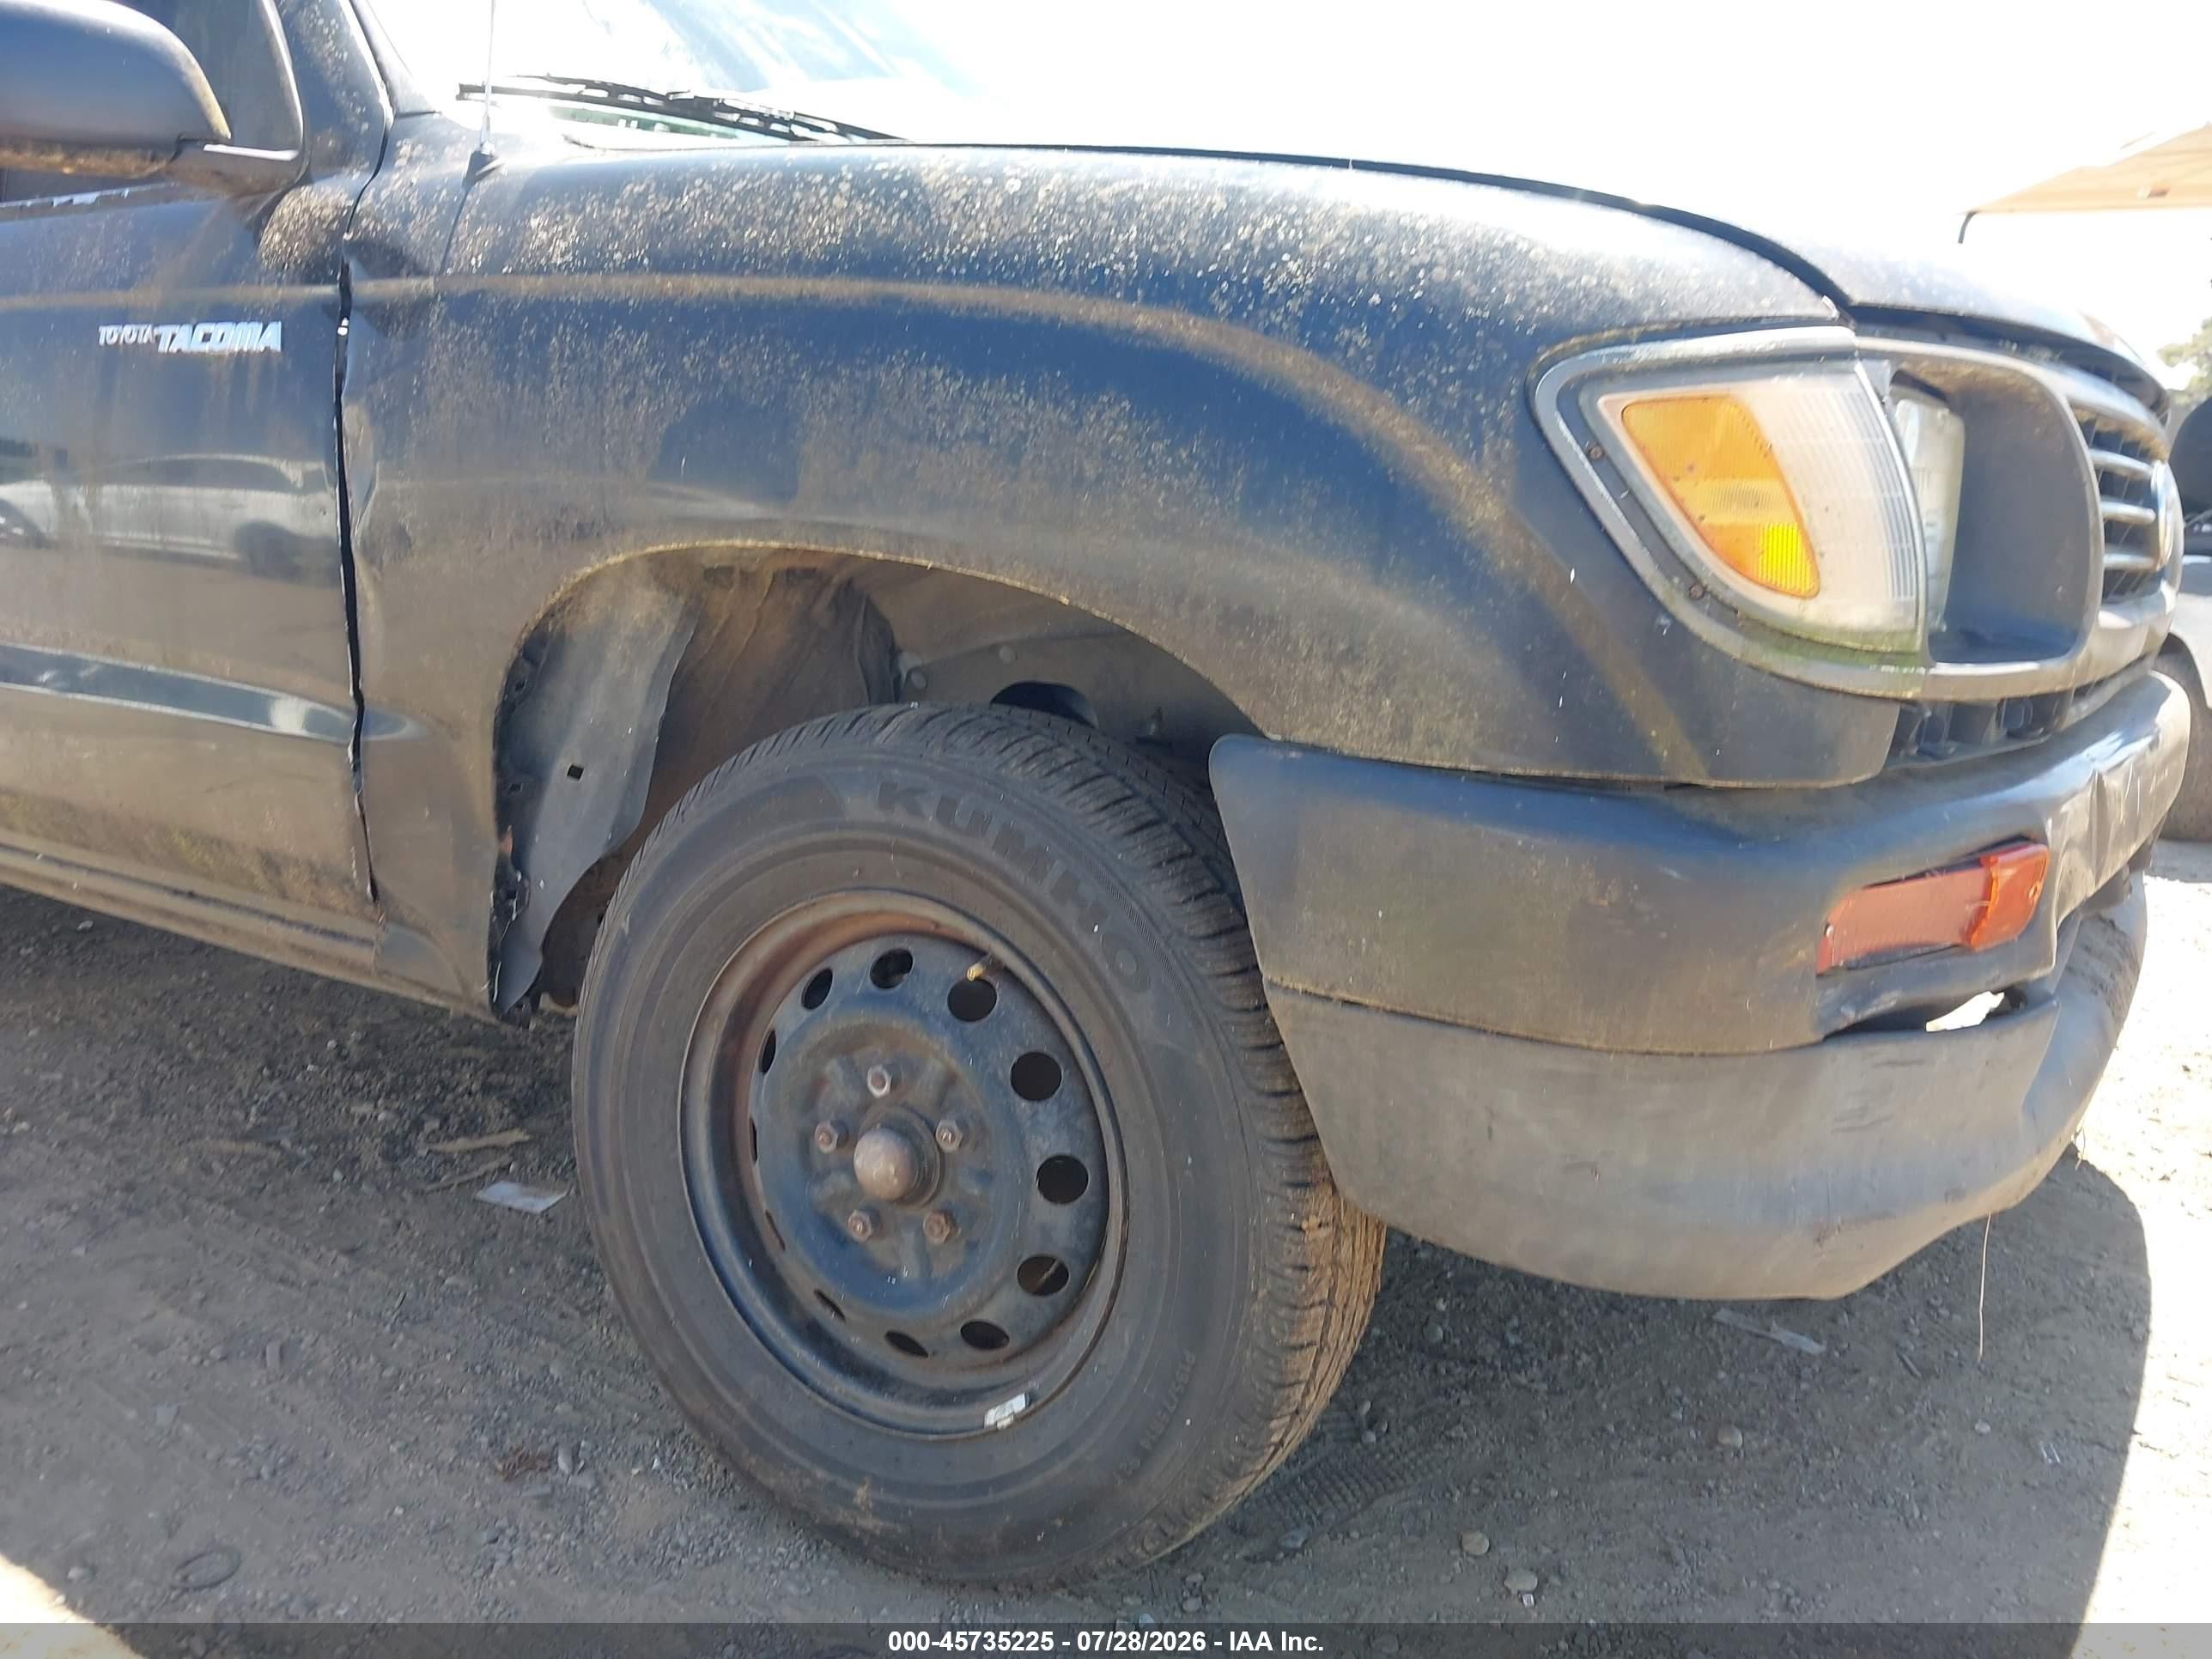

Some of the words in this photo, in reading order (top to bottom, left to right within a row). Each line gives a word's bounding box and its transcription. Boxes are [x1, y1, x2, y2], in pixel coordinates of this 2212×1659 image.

[98, 324, 154, 346] TOYOTA
[155, 321, 283, 353] TACOMA
[878, 780, 1152, 993] KUMHO
